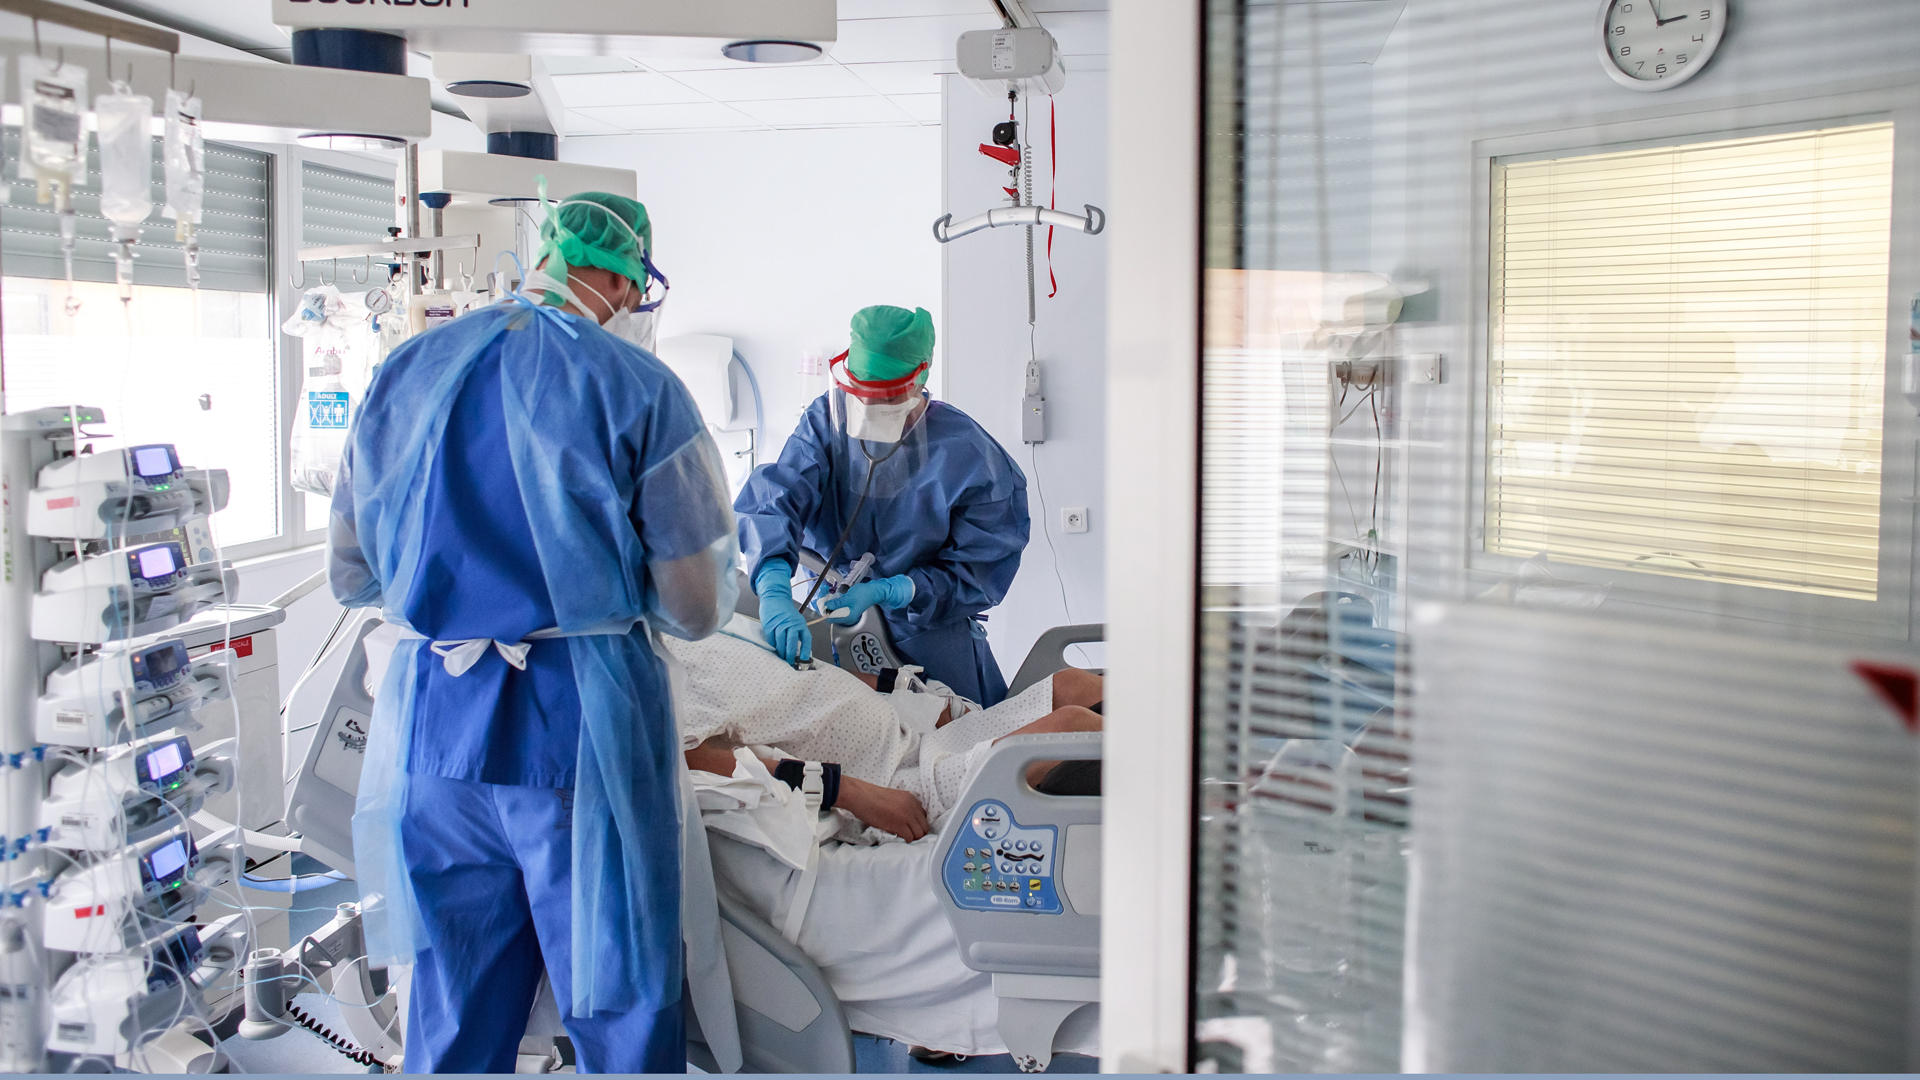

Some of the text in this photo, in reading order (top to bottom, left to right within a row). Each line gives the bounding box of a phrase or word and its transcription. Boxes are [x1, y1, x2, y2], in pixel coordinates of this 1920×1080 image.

[1620, 4, 1633, 14] 10
[1700, 9, 1710, 20] 3
[1615, 26, 1625, 36] 9
[1691, 33, 1704, 42] 4
[1620, 46, 1631, 56] 8
[1676, 54, 1688, 64] 5
[1635, 61, 1645, 71] 7
[1655, 63, 1667, 74] 6
